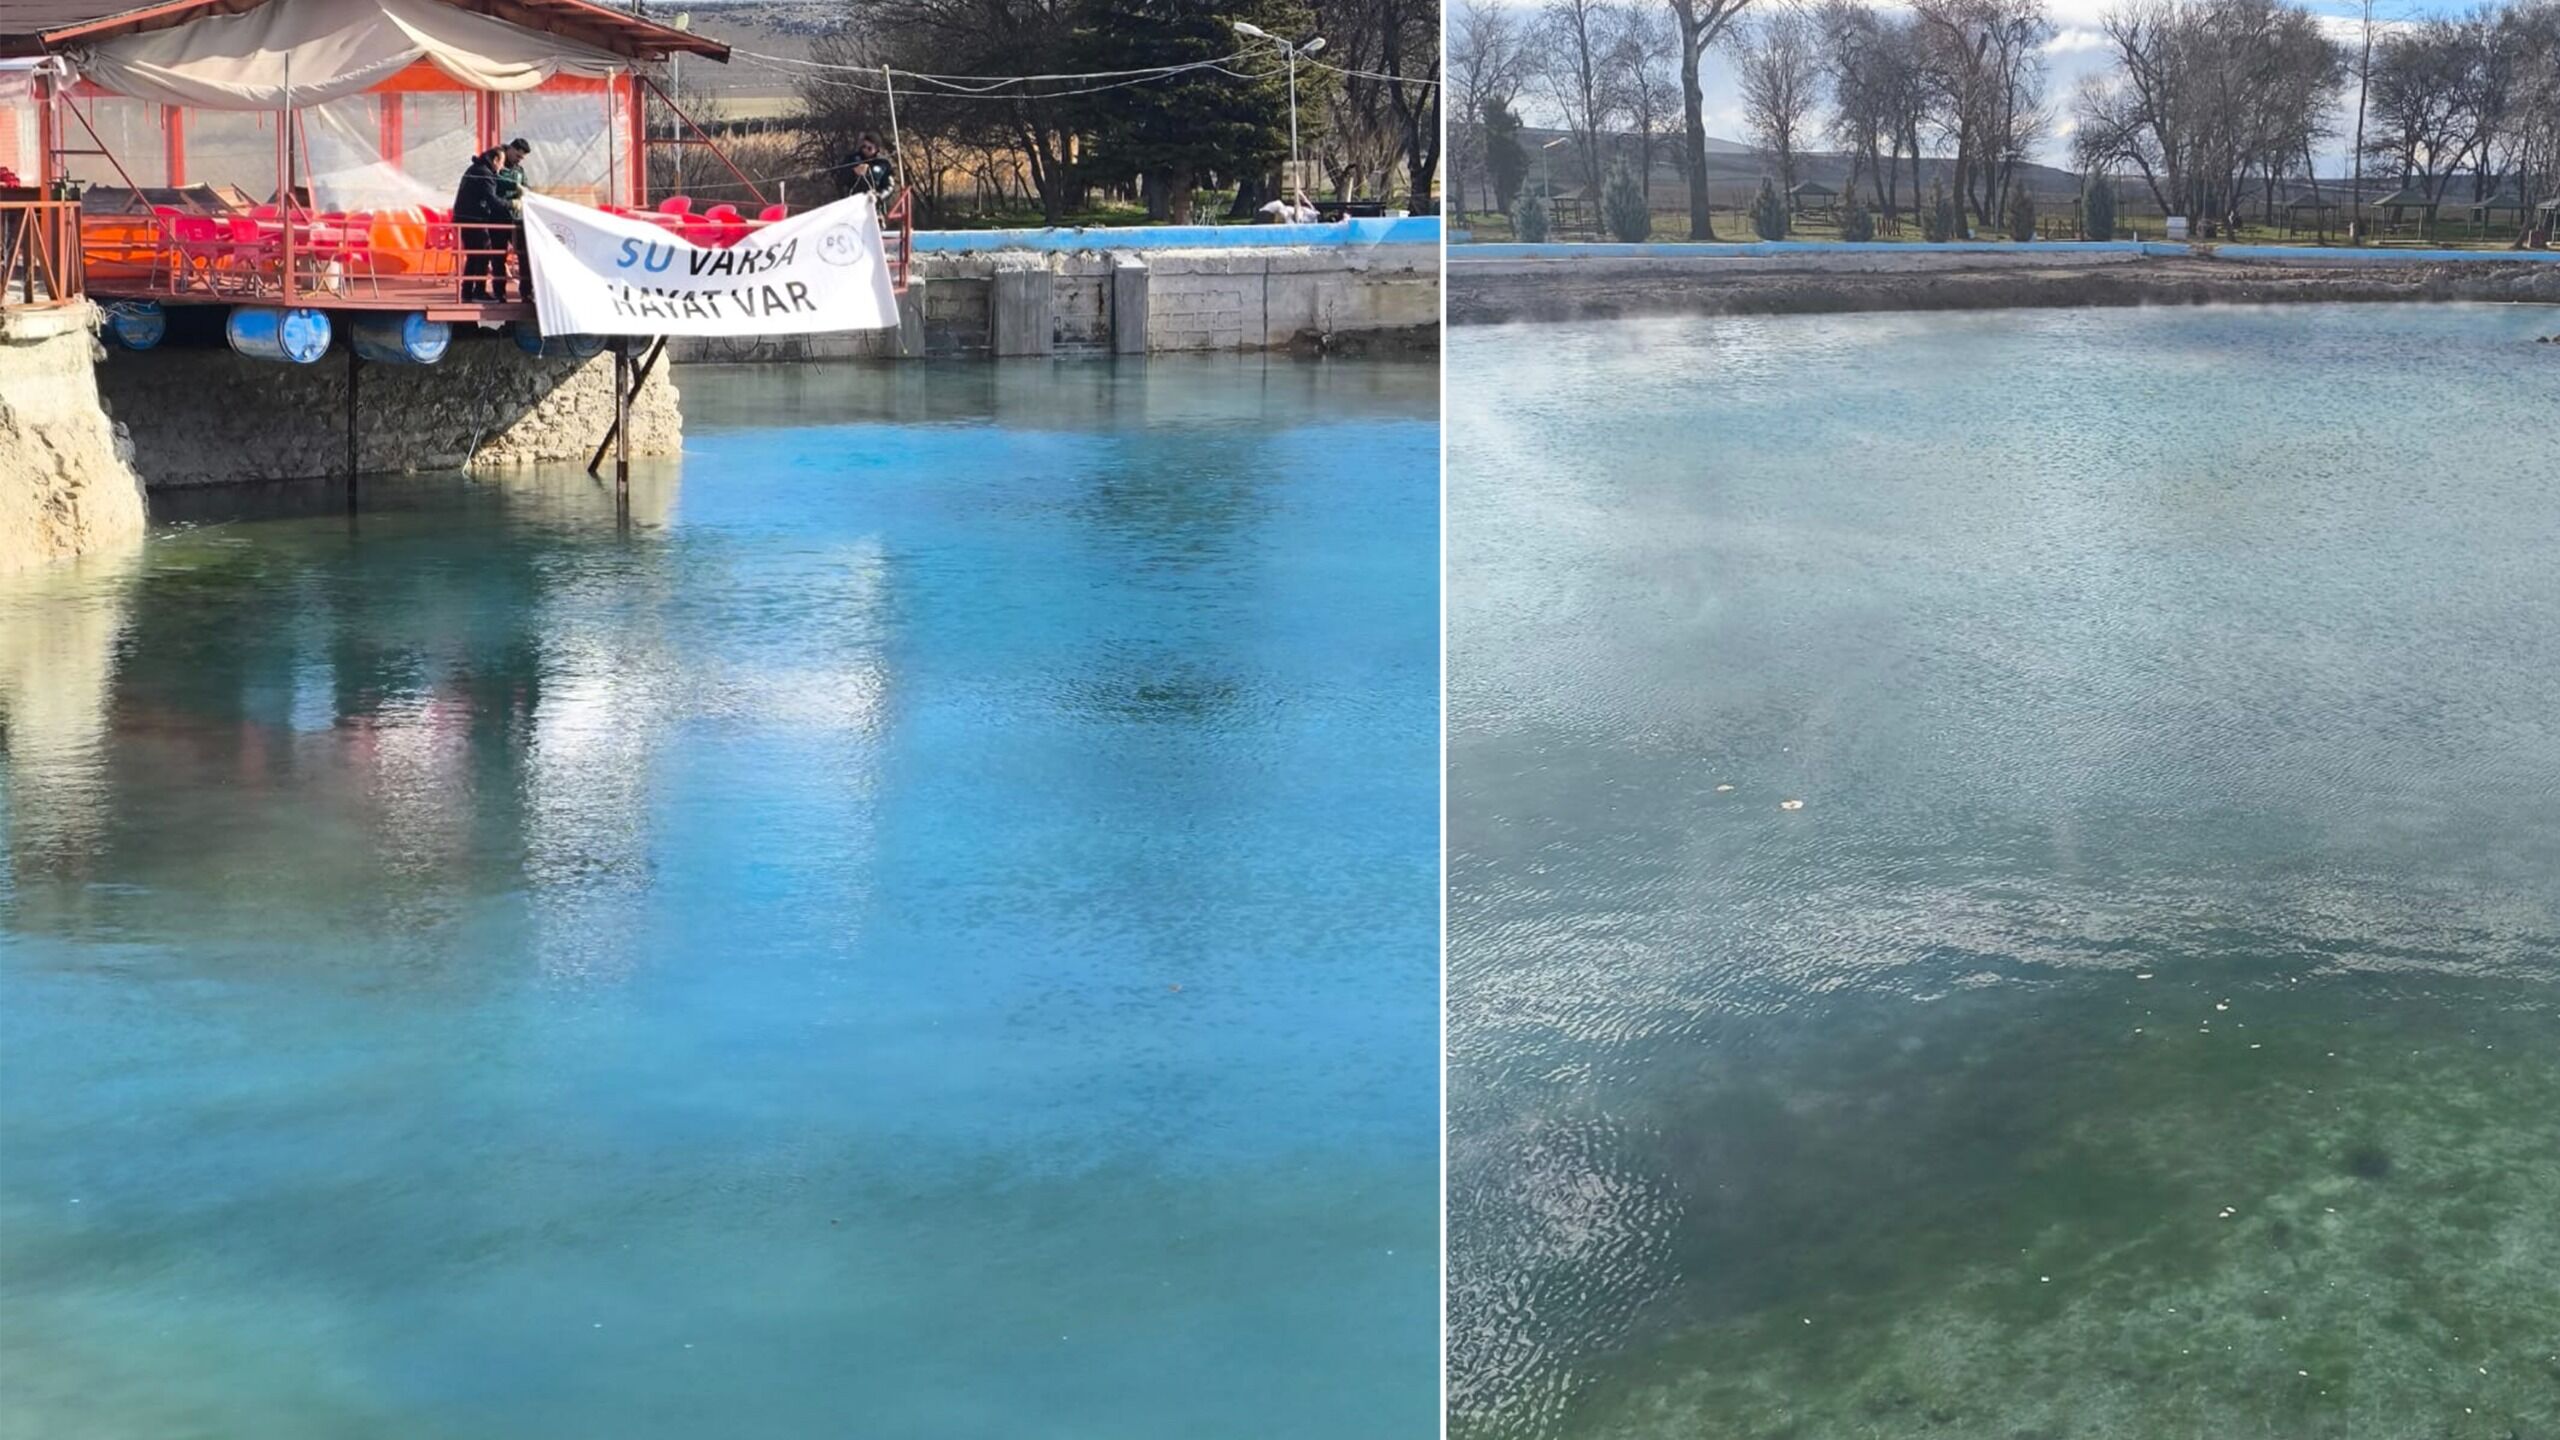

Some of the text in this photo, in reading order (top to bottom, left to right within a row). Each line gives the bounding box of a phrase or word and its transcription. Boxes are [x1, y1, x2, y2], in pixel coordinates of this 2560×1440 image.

[616, 237, 675, 273] SU
[690, 237, 798, 276] VARSA
[608, 281, 817, 319] HAYAT VAR
